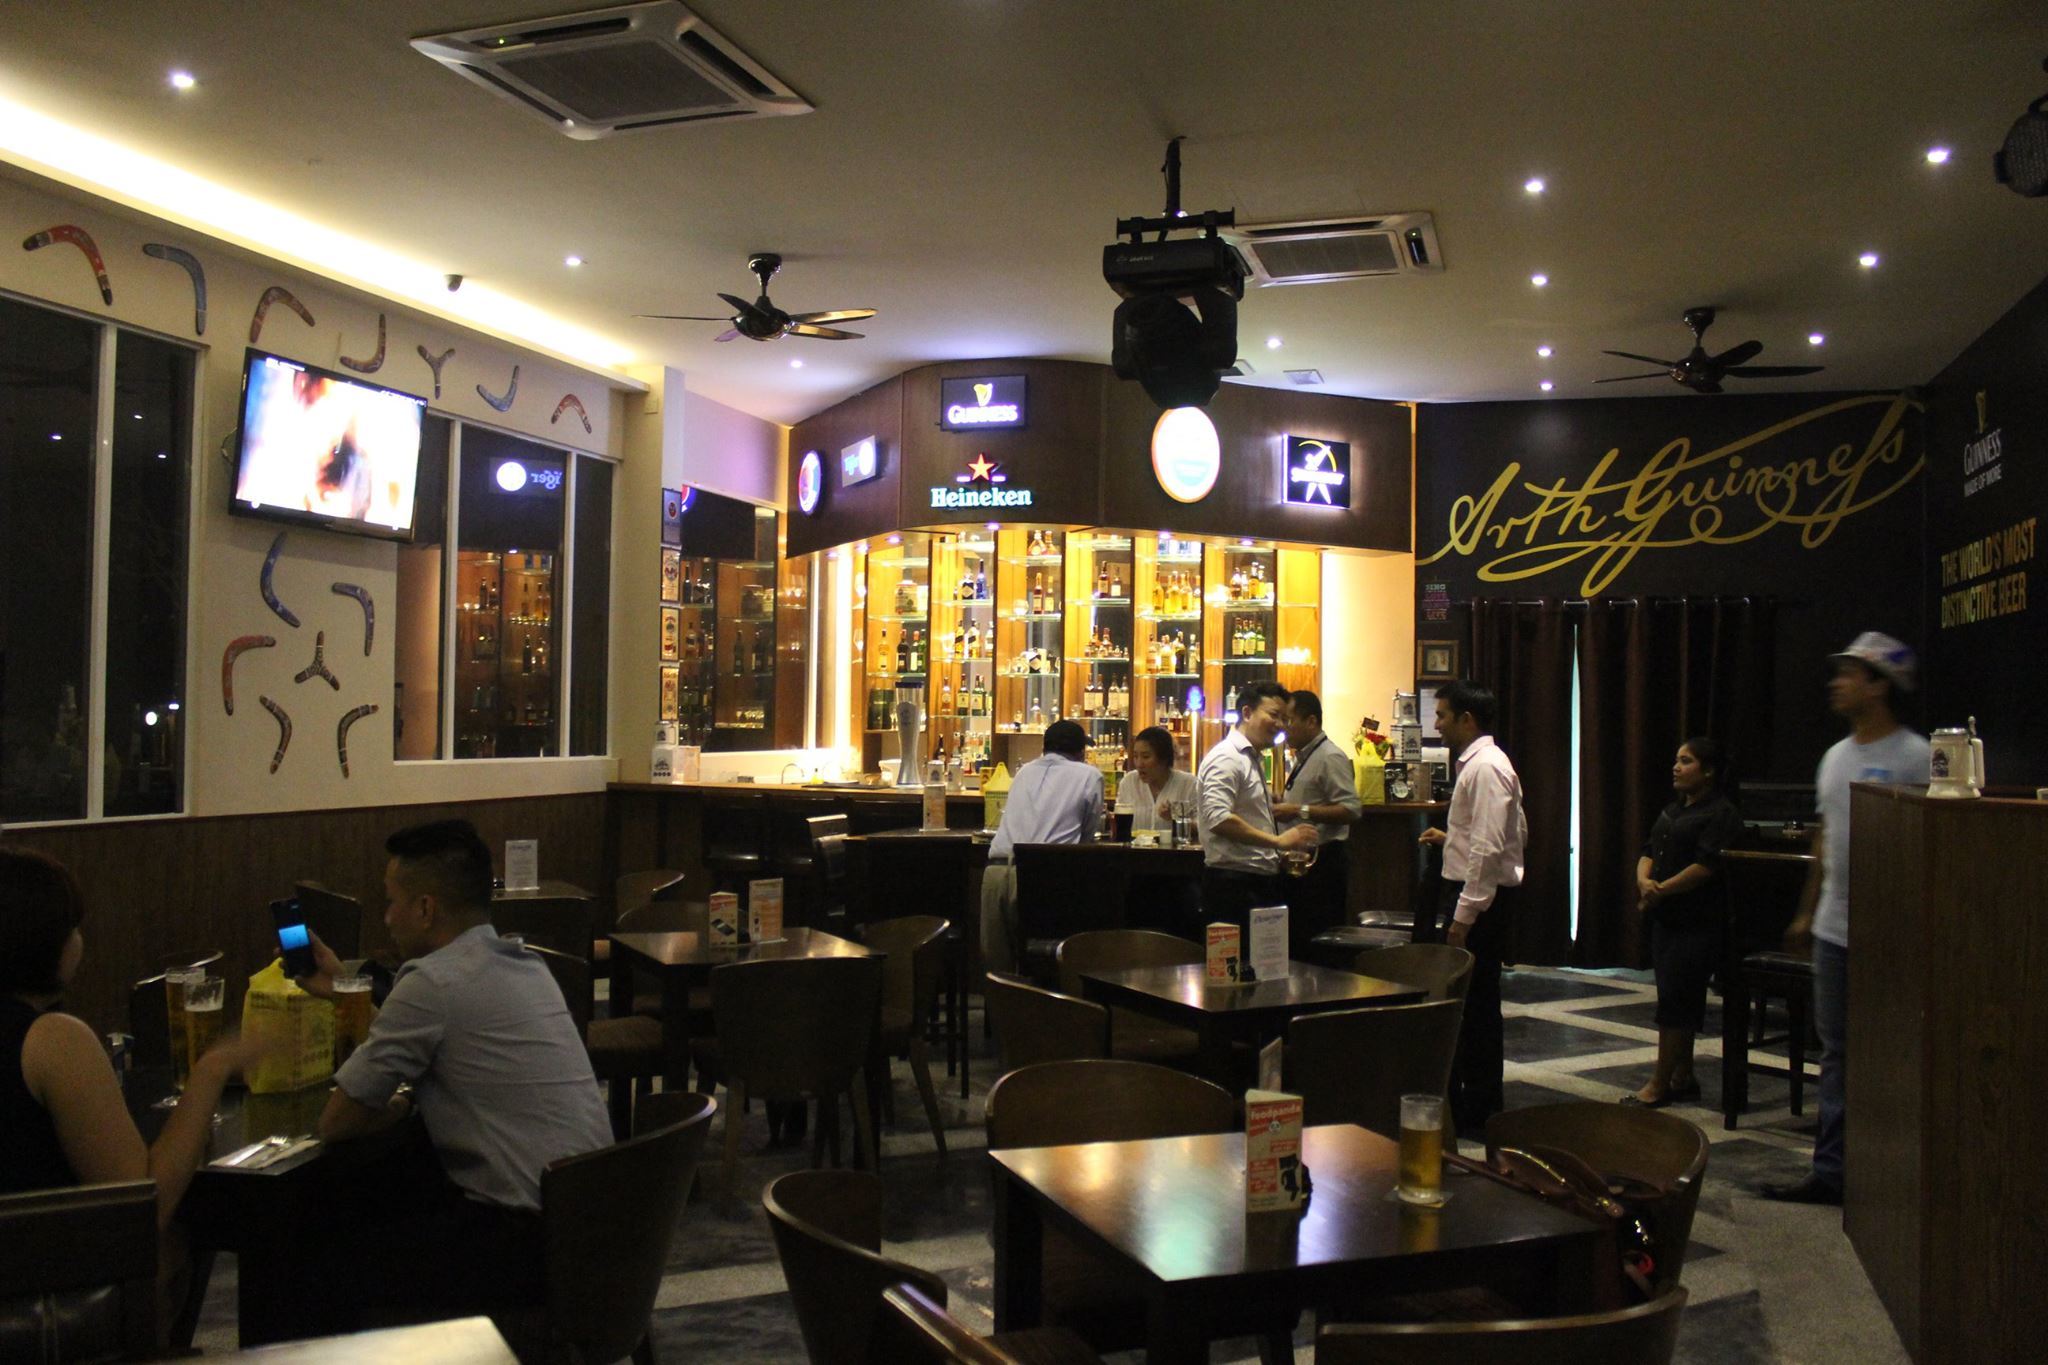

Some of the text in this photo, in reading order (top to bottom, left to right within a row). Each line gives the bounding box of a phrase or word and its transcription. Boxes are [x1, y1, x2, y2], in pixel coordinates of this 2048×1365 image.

[1963, 428, 2002, 476] GUINNESS
[931, 487, 1032, 508] Heineken
[1940, 517, 2037, 589] THE WORLD'S MOST
[1941, 570, 2027, 630] DISTINCTIVE BEER
